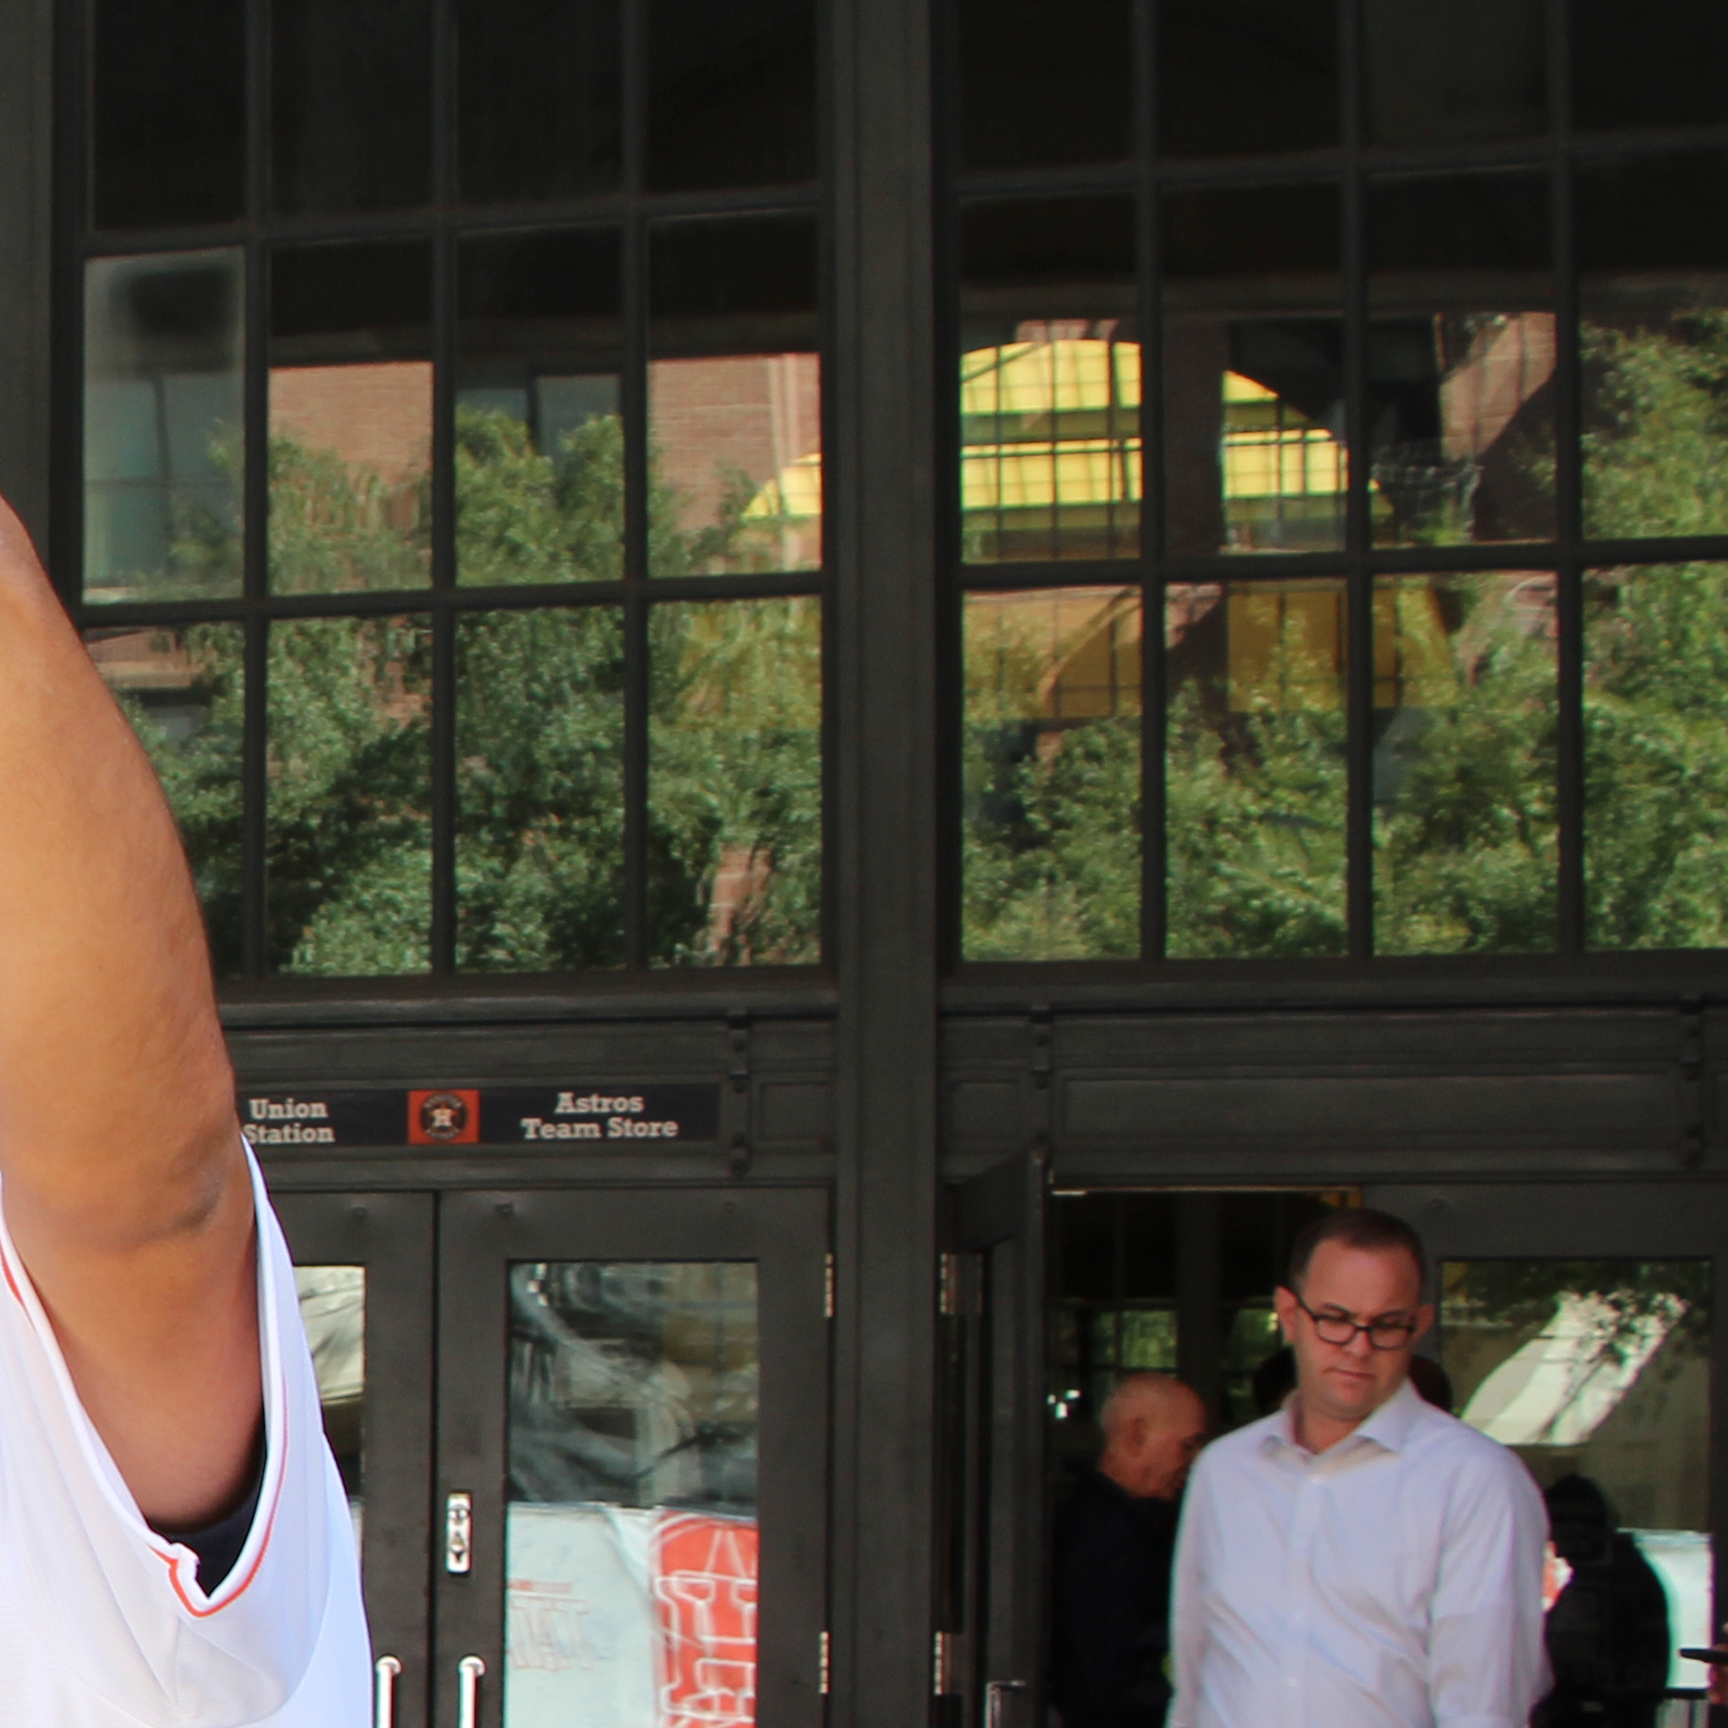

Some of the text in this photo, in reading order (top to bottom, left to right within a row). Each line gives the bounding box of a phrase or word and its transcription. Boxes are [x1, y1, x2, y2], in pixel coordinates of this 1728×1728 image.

[249, 1098, 329, 1119] Union
[553, 1091, 645, 1114] Astros
[243, 1122, 336, 1144] Station
[520, 1116, 679, 1140] Team Store
